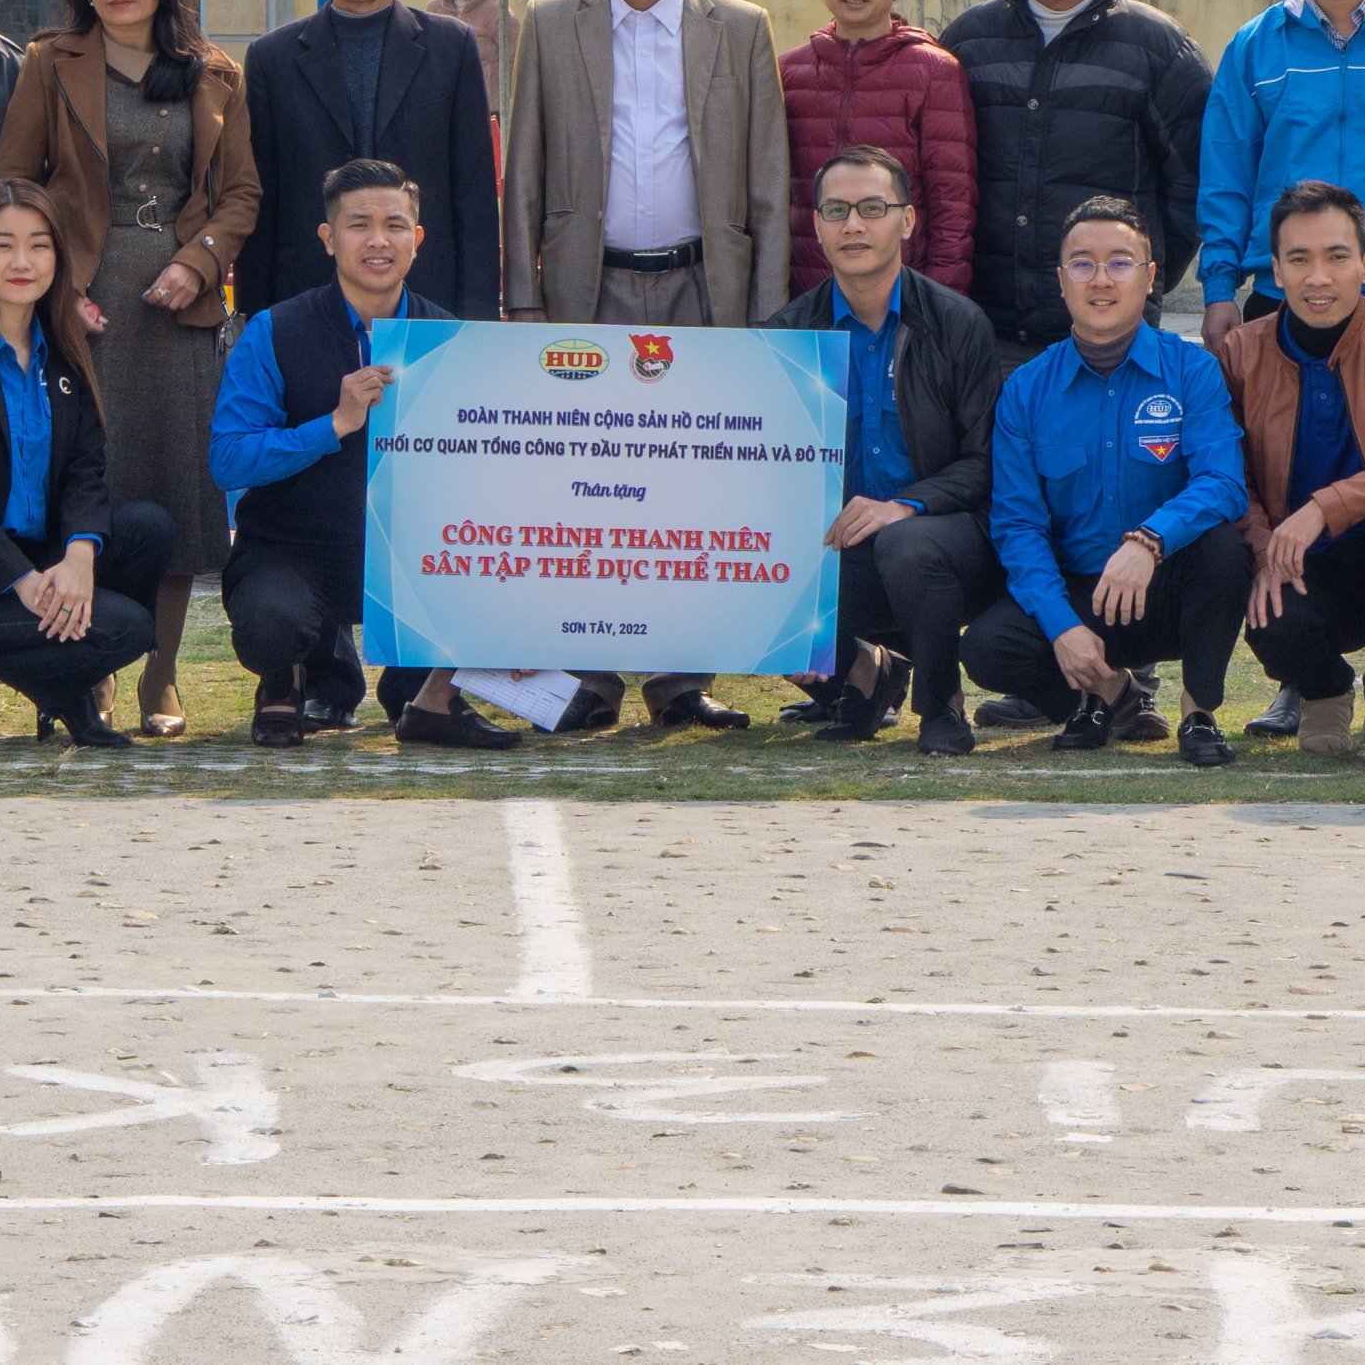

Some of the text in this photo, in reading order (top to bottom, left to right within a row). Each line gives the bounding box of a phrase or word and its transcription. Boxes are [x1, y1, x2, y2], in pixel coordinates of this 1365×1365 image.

[545, 351, 603, 368] HUD
[457, 406, 762, 431] ĐOÀN THANH NIÊN CỘNG SẢN HỒ CHÍ MINH
[374, 434, 843, 465] KHỐI CƠ QUAN TỔNG CÔNG TY ĐẦU TƯ PHÁT TRIỂN NHÀ VÀ ĐÔ THỊ
[571, 481, 646, 501] Thân tặng
[442, 519, 771, 552] CÔNG TRÌNH THANH NIÊN
[421, 549, 790, 585] SÂN TẬP THỂ DỤC THỂ THAO
[561, 620, 647, 636] SƠN TÂY, 2022
